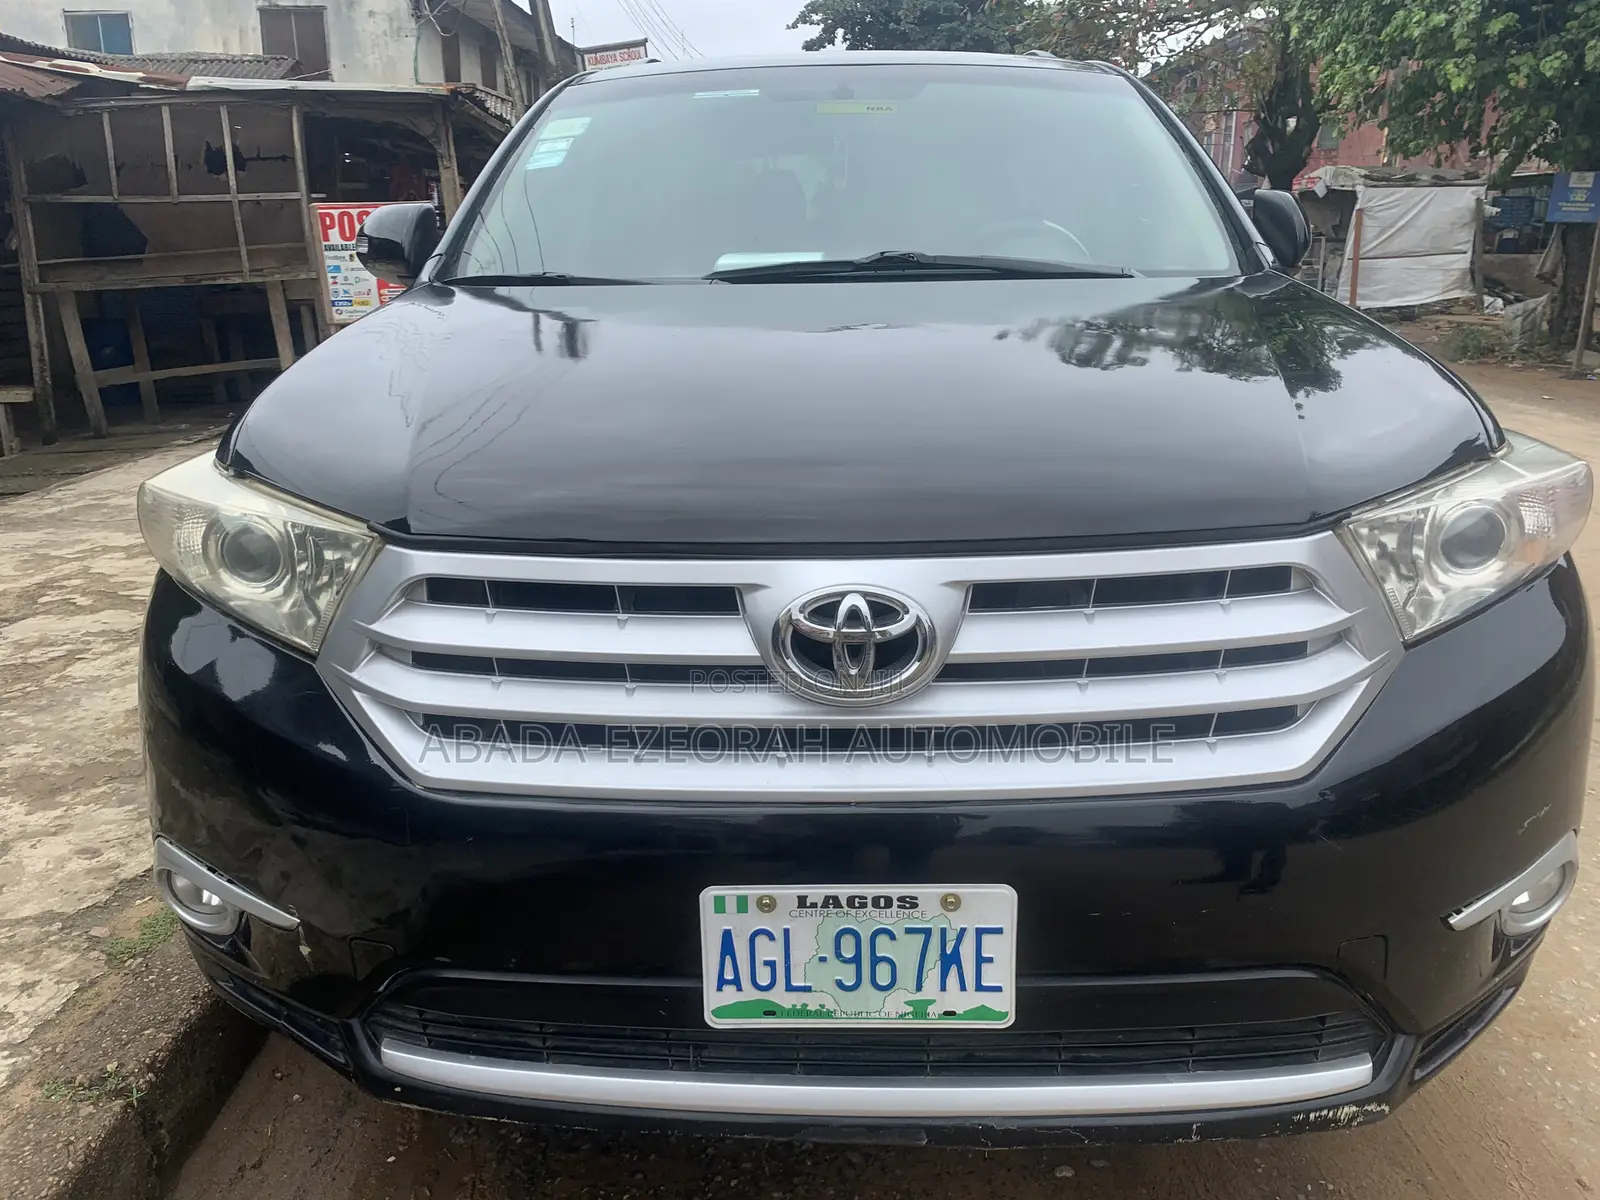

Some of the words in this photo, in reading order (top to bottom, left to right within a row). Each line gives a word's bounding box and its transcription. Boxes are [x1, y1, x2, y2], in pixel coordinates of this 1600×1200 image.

[323, 243, 357, 252] AVAILABLE
[796, 894, 920, 910] LAGOS
[788, 909, 834, 919] CENTRE
[835, 909, 851, 919] OF
[855, 909, 928, 919] EXCELLENCE
[780, 1009, 823, 1018] FEDERAL
[878, 1010, 893, 1018] OF
[895, 1010, 938, 1018] NIGERIA
